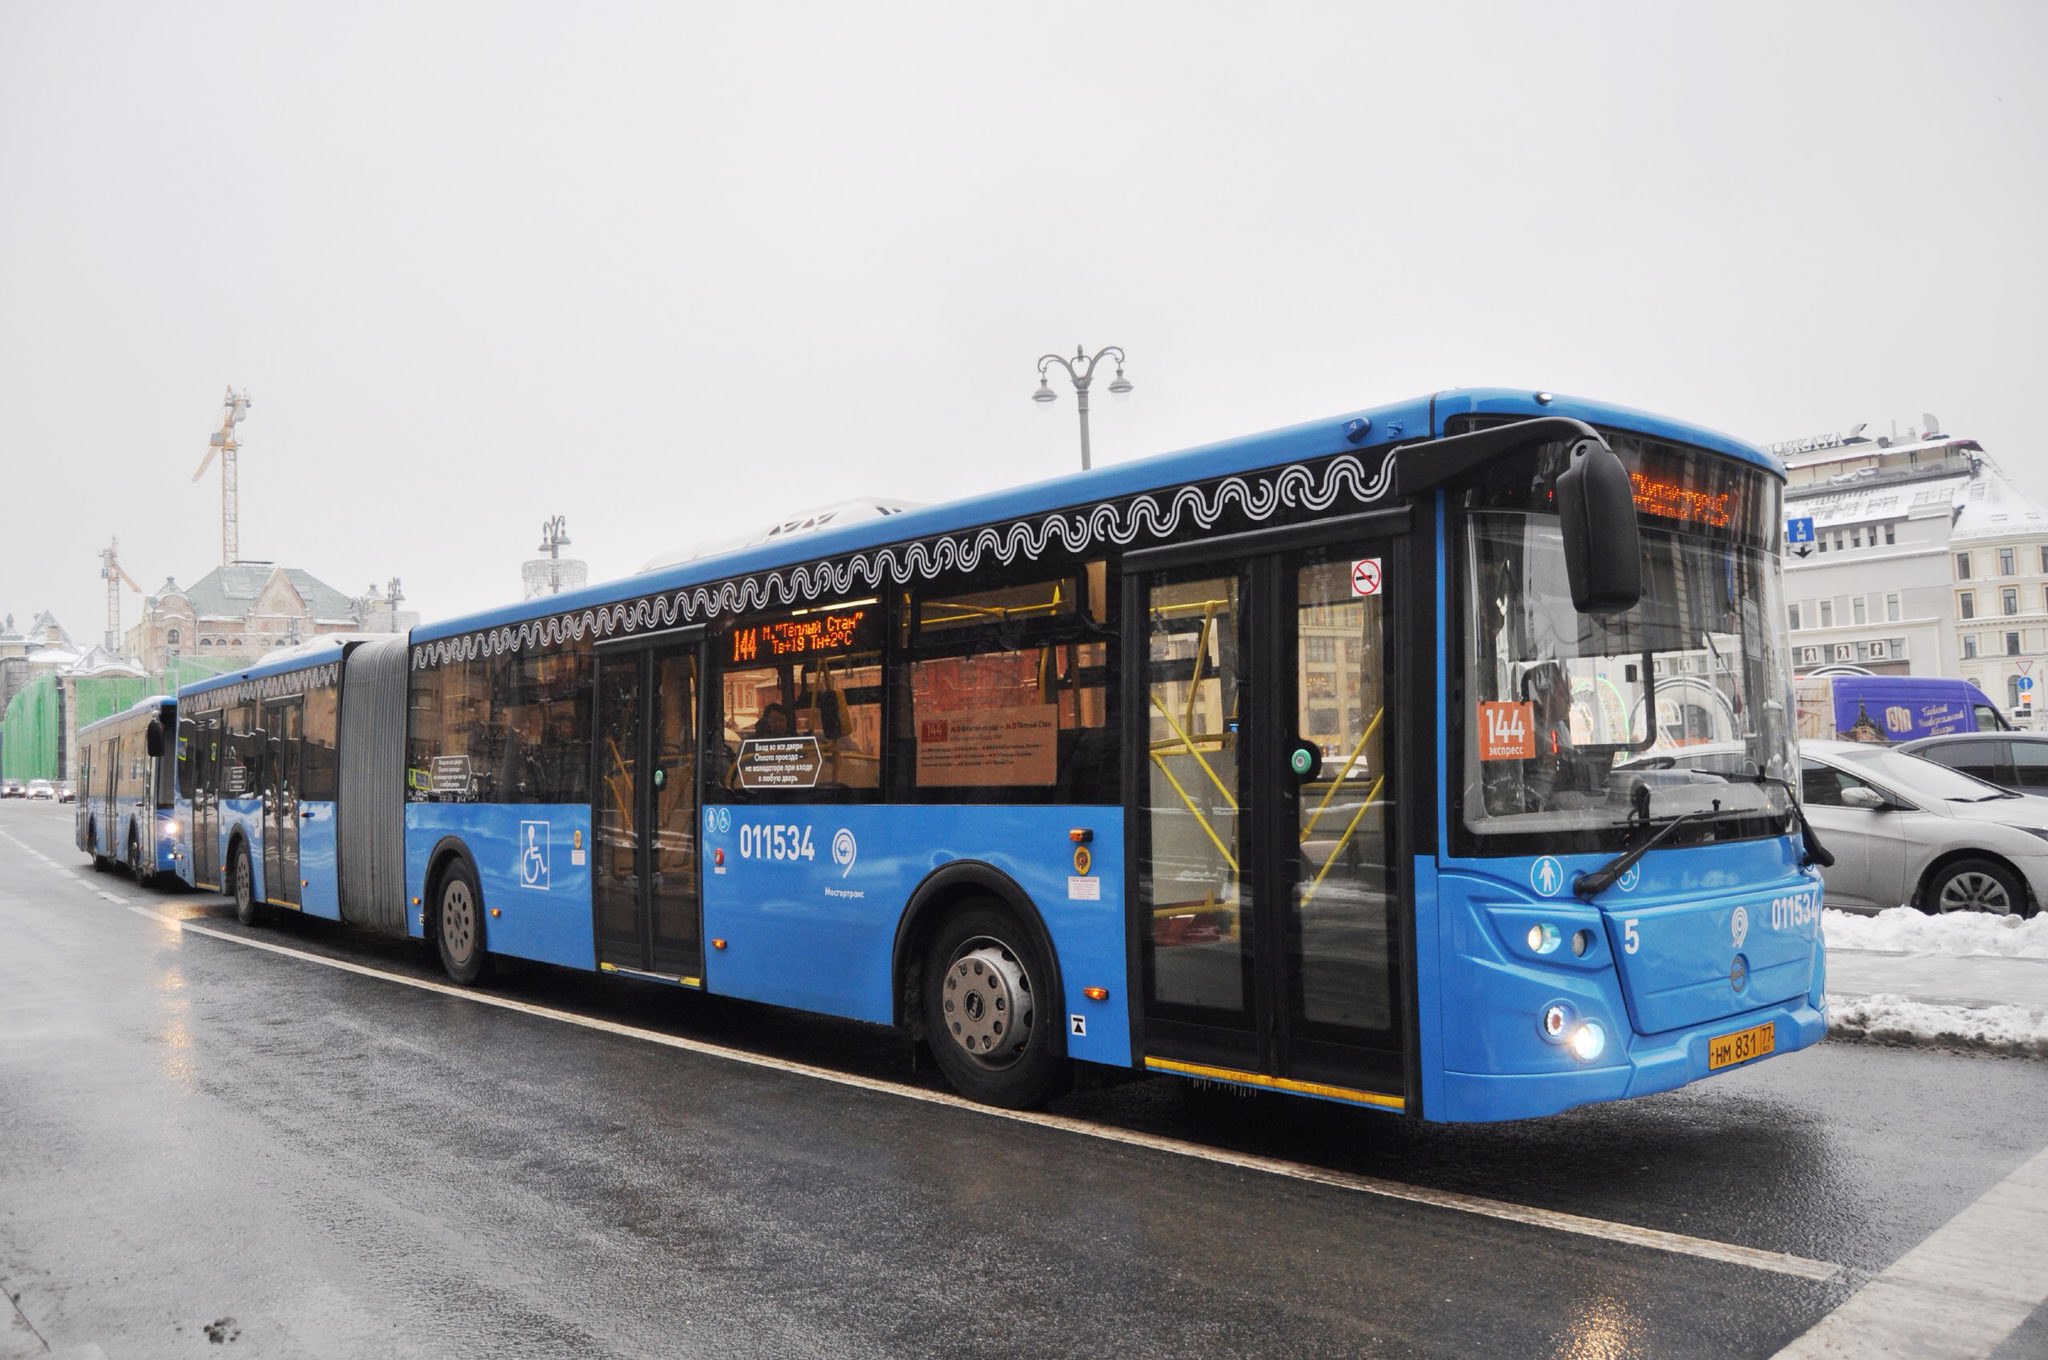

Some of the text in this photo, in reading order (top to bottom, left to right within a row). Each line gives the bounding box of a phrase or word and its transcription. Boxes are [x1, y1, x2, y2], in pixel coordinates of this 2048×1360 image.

[733, 628, 757, 661] 144
[1486, 708, 1525, 744] 144
[754, 753, 774, 762] Оплата
[775, 754, 798, 763] проезда
[755, 743, 769, 752] Вход
[786, 743, 804, 752] двери
[1488, 745, 1524, 757] экспресс
[782, 775, 798, 784] дверь
[740, 824, 815, 861] 011534
[824, 887, 865, 899] Мосгортранс
[1771, 891, 1820, 931] 011534
[1624, 918, 1640, 955] 5
[1715, 1026, 1772, 1064] НМ 831 77
